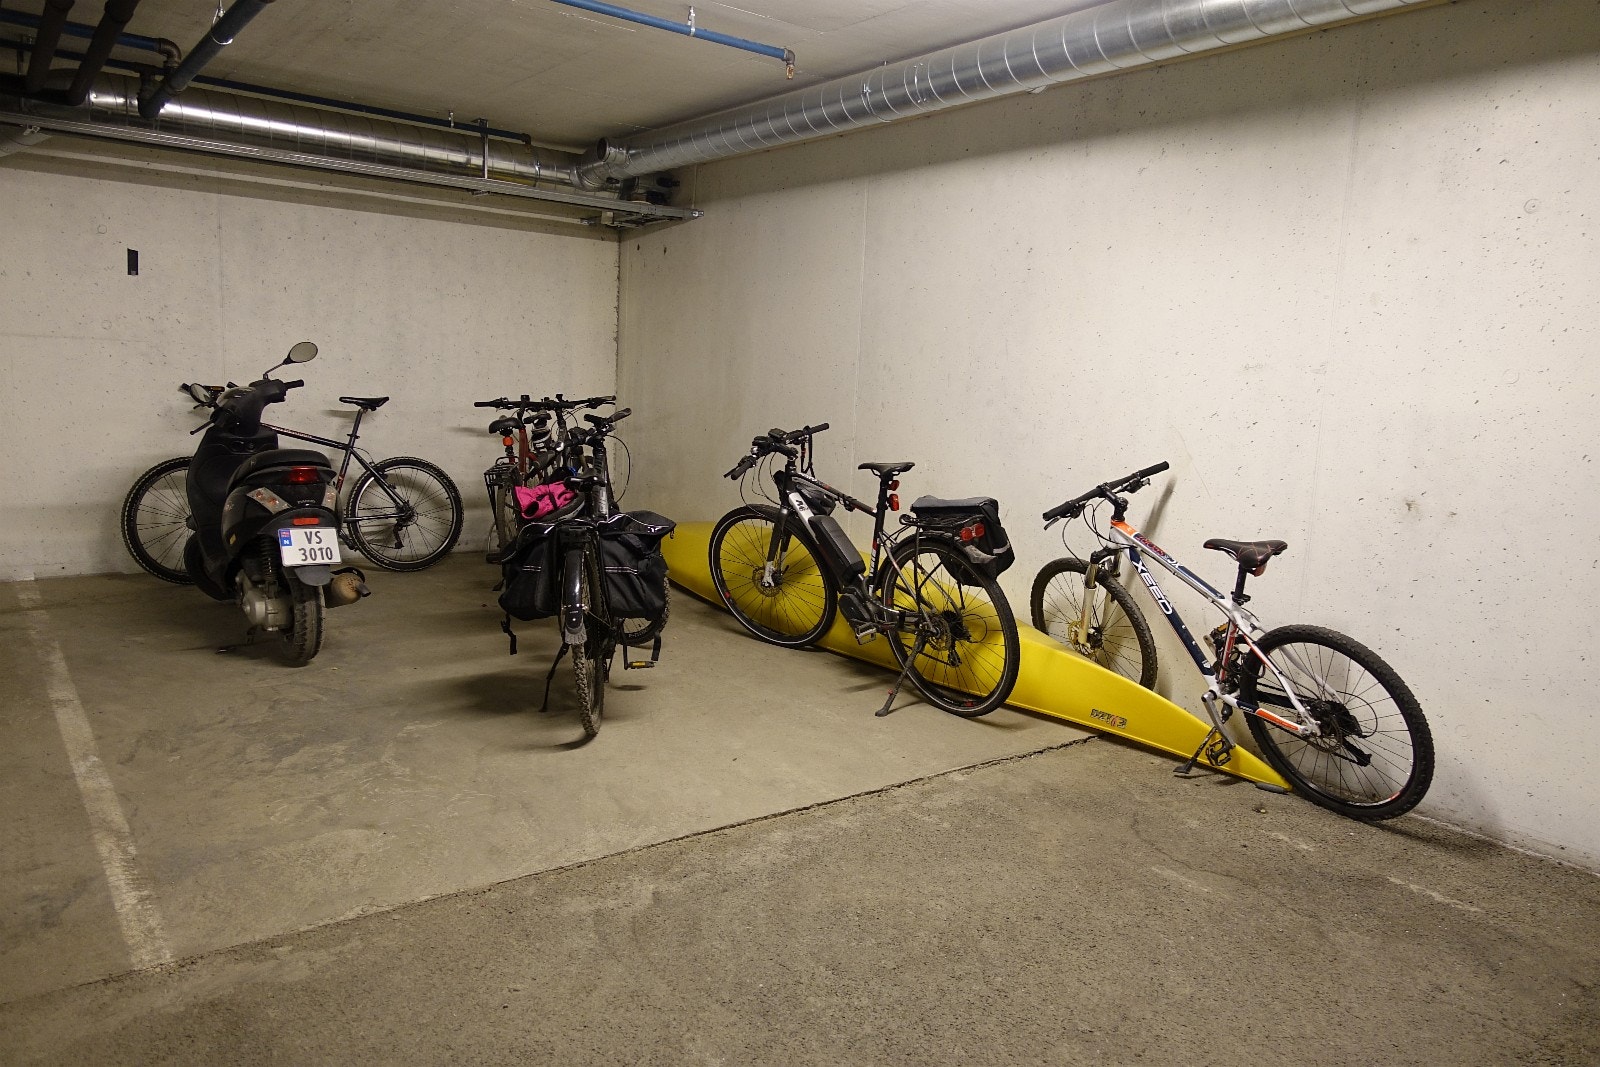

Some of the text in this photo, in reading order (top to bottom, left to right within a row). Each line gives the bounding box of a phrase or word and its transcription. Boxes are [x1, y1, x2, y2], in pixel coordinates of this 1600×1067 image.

[304, 530, 323, 545] VS
[298, 546, 333, 562] 3010
[1131, 560, 1173, 614] XEED
